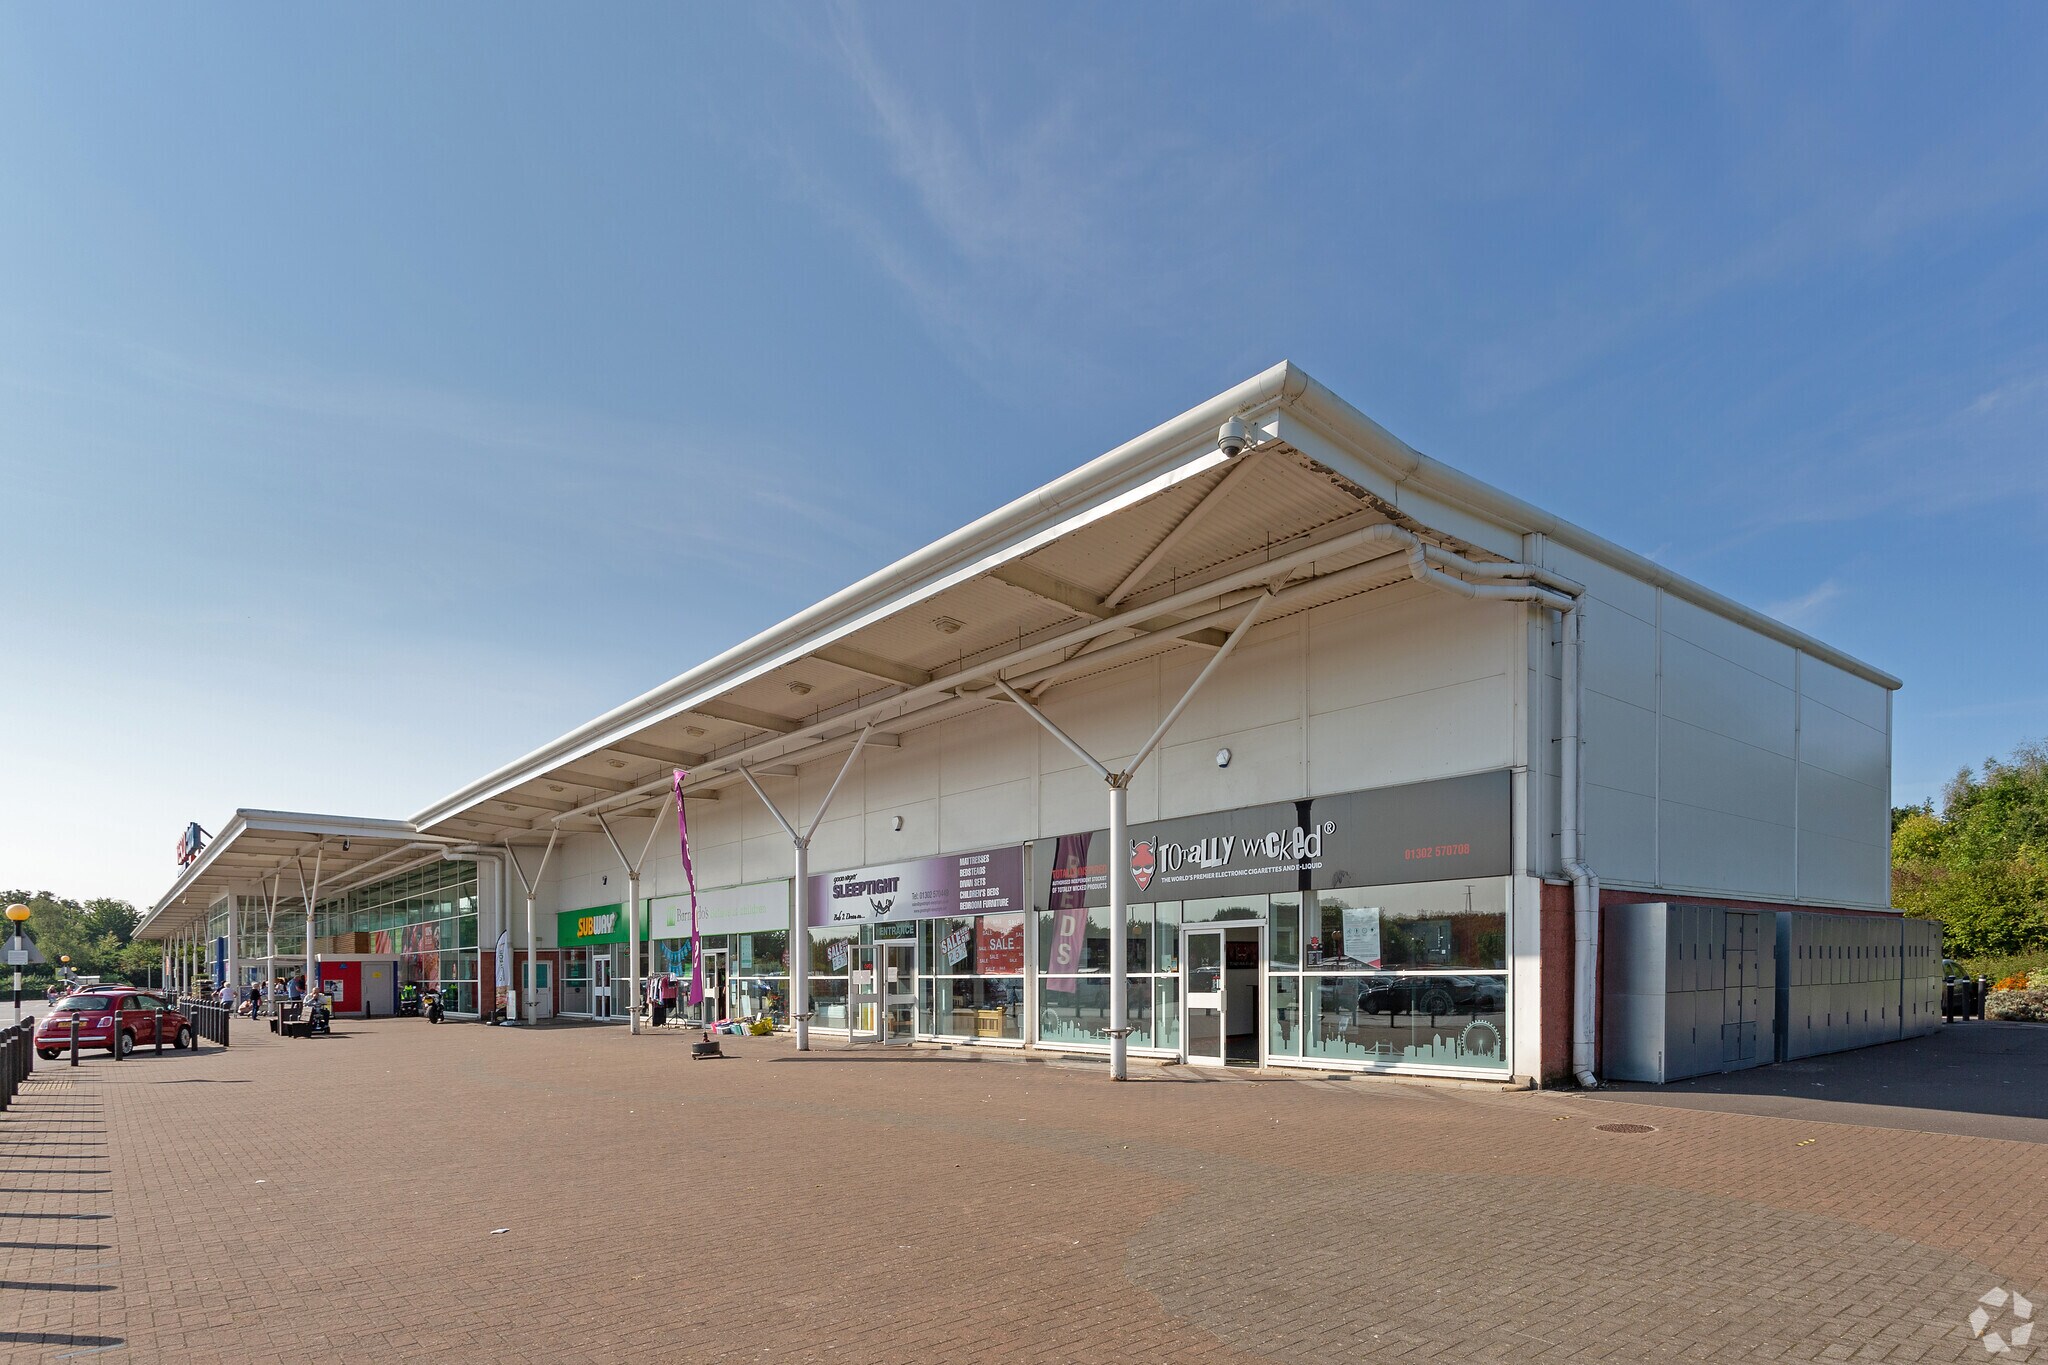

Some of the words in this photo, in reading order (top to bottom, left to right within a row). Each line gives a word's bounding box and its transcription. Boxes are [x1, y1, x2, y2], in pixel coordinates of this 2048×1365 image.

[1404, 847, 1433, 860] 01302
[1435, 843, 1470, 857] 570708
[960, 854, 990, 867] MATTRESSES
[960, 866, 986, 877] BEDSTEADS
[1171, 874, 1194, 882] WORLD'S
[1194, 872, 1215, 880] PREMIER
[1215, 869, 1248, 878] ELECTRONIC
[1248, 865, 1283, 875] CIGARETTES
[1283, 864, 1296, 872] AND
[1296, 862, 1323, 870] E-LIQUID
[833, 877, 899, 899] SLEEPTIGHT
[960, 879, 974, 888] DIVAN
[974, 877, 986, 887] SETS
[960, 889, 986, 899] CHILDREN'S
[987, 887, 1000, 897] BEDS
[960, 900, 982, 910] BEDROOM
[983, 898, 1009, 909] FURNITURE
[577, 912, 616, 938] SUBWAY
[880, 925, 915, 936] ENTRANCE
[941, 931, 962, 954] SALE
[989, 937, 1015, 951] SALE
